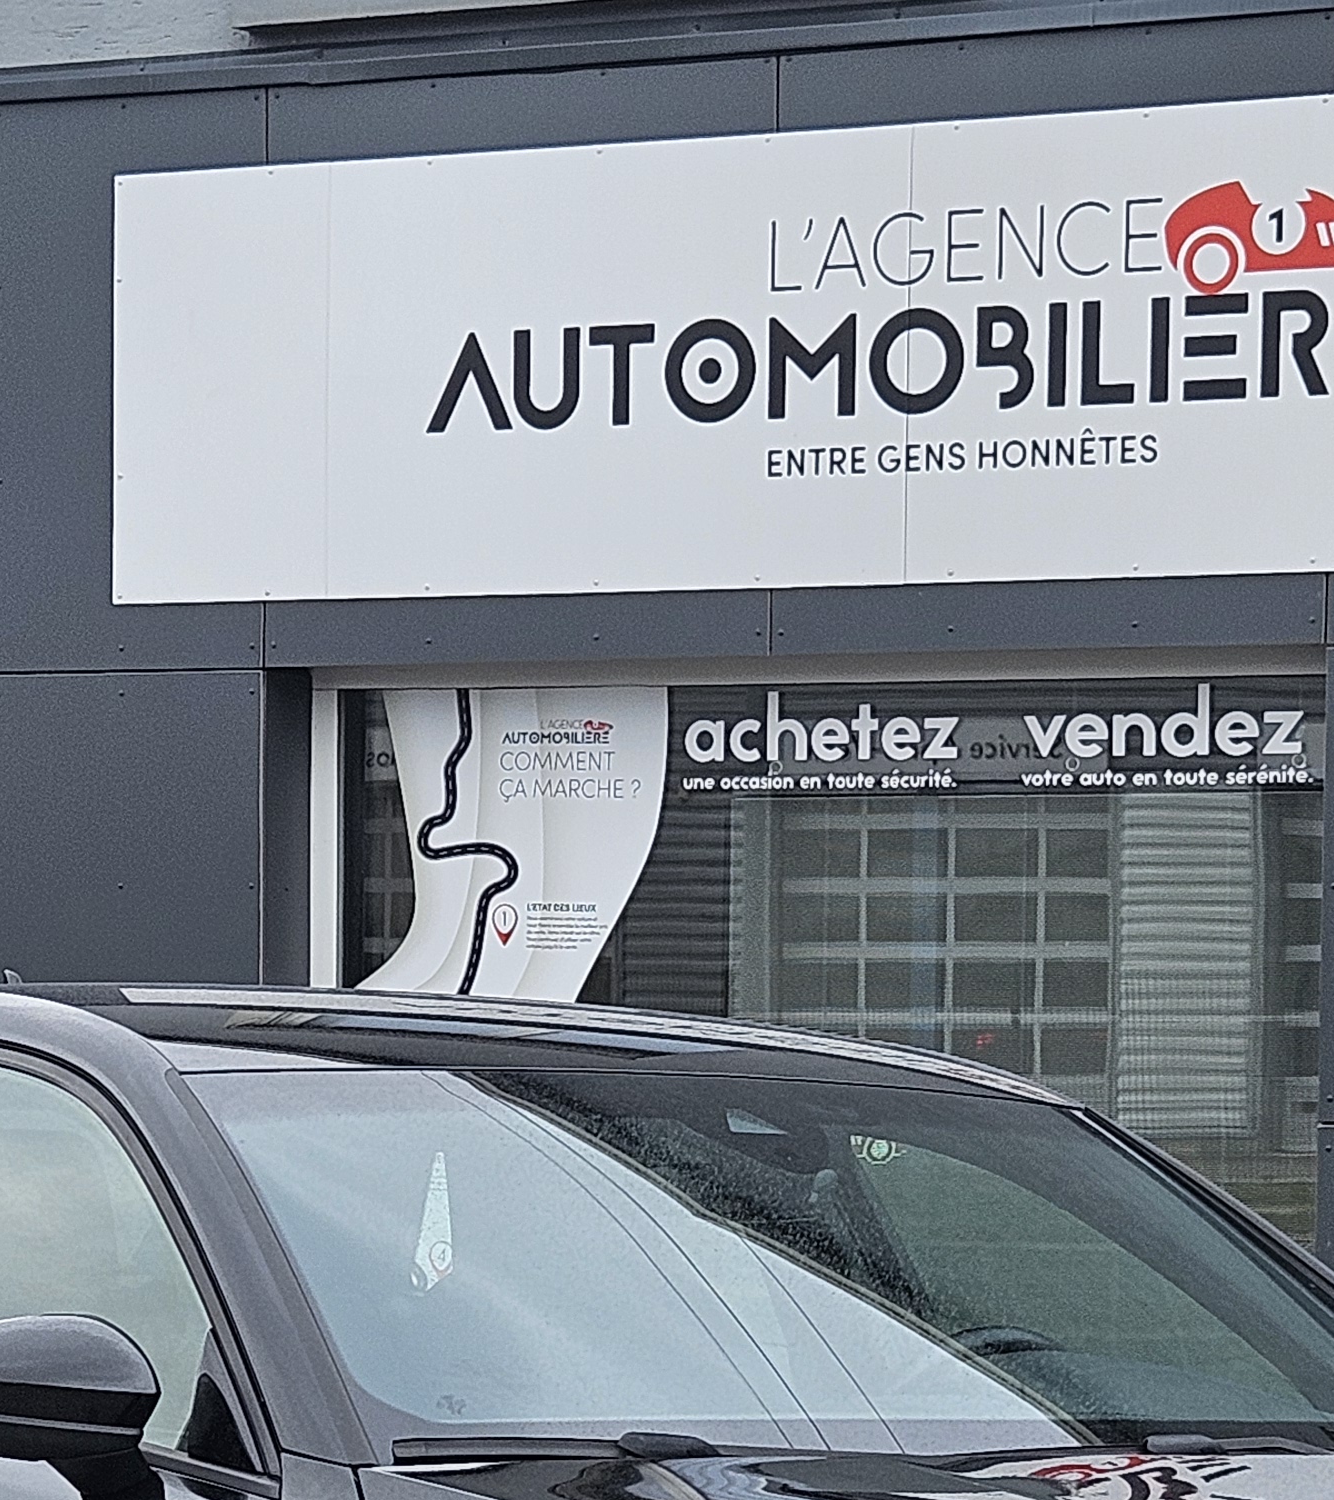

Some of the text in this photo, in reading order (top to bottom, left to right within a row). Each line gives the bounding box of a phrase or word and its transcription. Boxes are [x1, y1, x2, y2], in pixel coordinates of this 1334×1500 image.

[768, 198, 1163, 293] L'AGENCE
[768, 427, 1159, 478] ENTRE GENS HONNÊTES
[684, 690, 960, 763] achetez
[1023, 682, 1305, 759] vendez
[499, 751, 616, 772] COMMENT
[683, 768, 958, 790] une occasion en toute sécurité.
[1021, 763, 1314, 787] votre auto en toute sérénité.
[499, 778, 642, 803] ÇA MARCHE ?
[502, 911, 507, 927] 1
